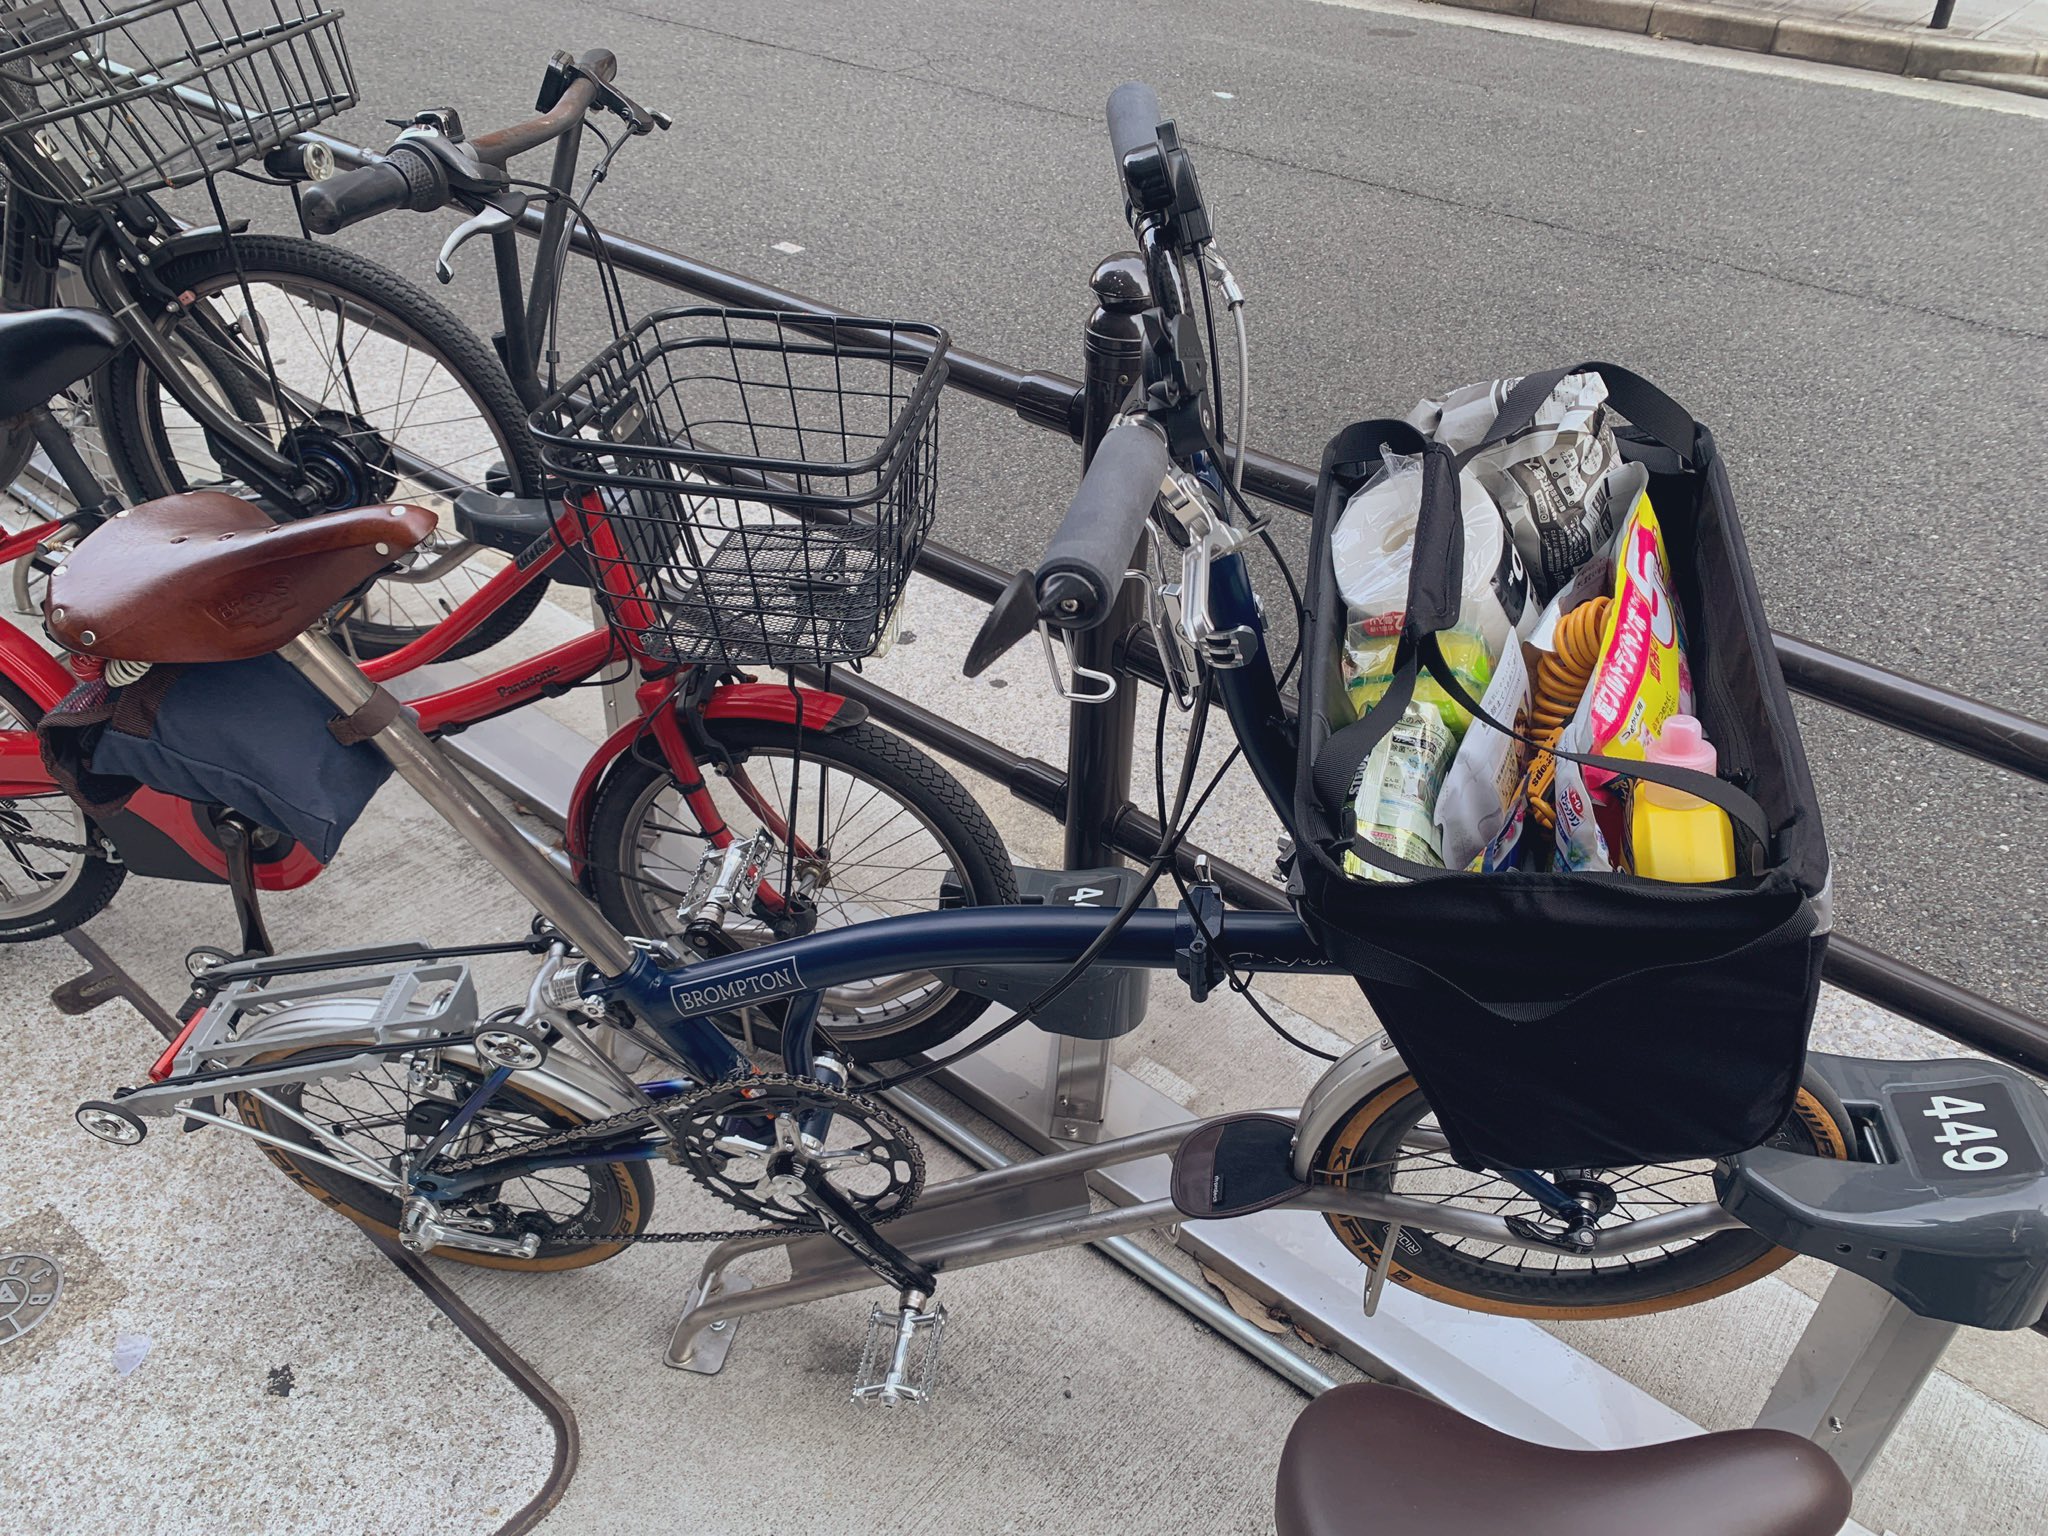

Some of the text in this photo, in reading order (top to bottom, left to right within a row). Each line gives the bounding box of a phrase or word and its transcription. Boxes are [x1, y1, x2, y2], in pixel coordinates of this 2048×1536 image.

[496, 665, 561, 697] Panasonic
[1560, 790, 1580, 827] マジックリン
[1068, 887, 1104, 907] 4
[680, 968, 793, 1010] BROMPTON
[1922, 1095, 2009, 1171] 449
